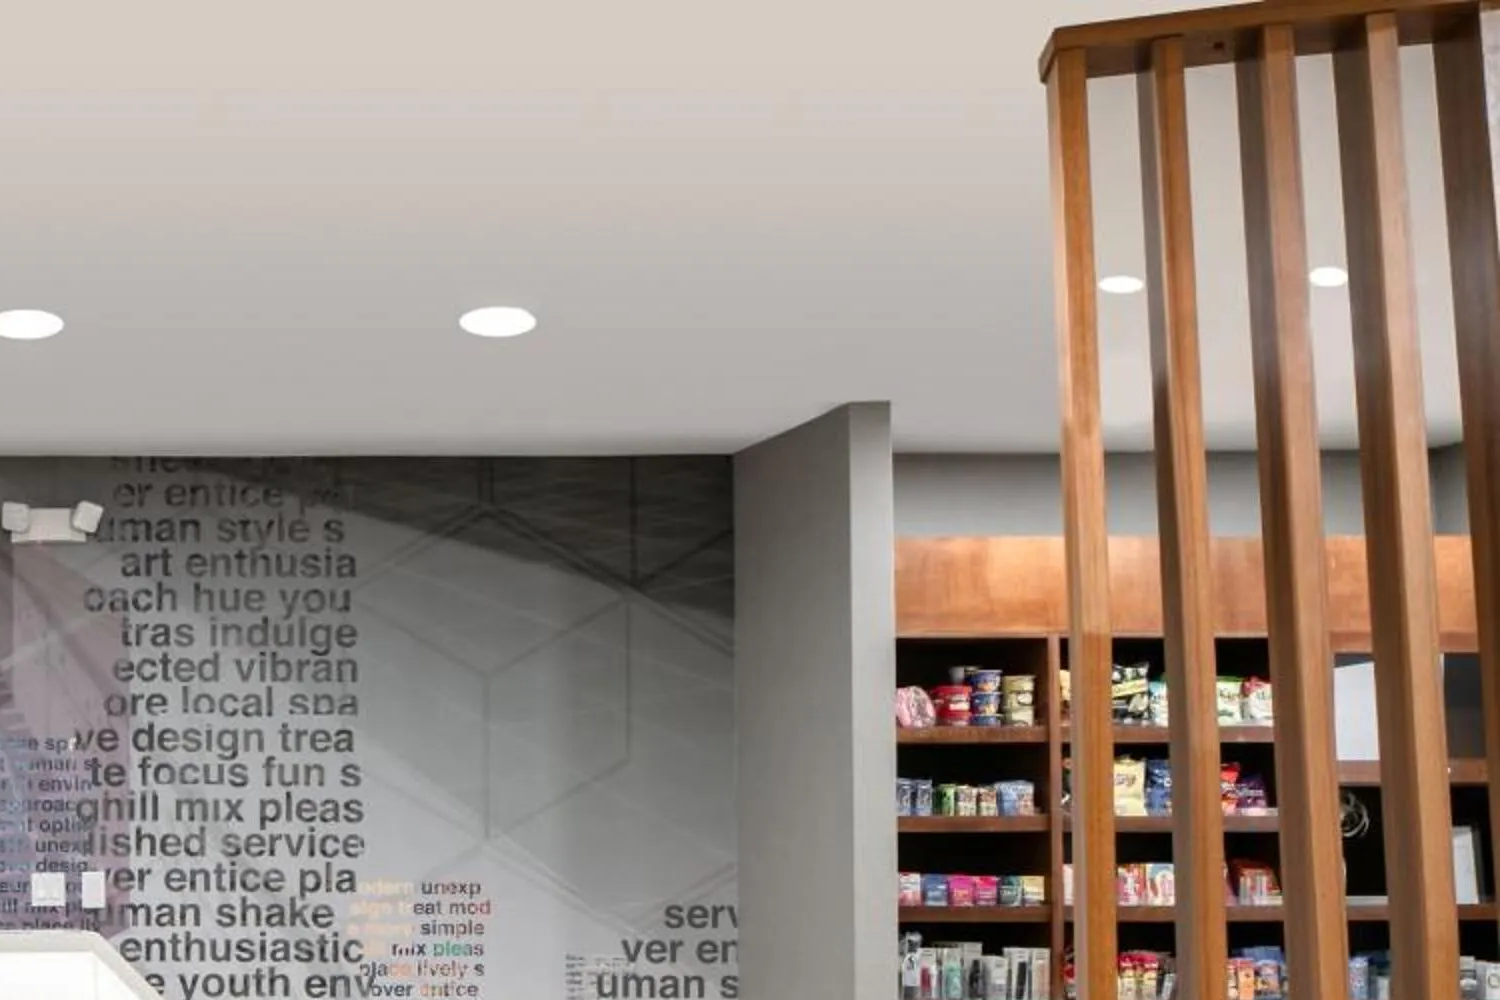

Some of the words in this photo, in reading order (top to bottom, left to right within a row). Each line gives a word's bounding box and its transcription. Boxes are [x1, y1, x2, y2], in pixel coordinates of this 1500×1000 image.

[216, 513, 311, 550] style
[323, 517, 346, 544] s
[120, 548, 174, 578] art
[185, 546, 357, 579] enthusia
[193, 582, 266, 613] hue
[279, 587, 351, 620] you
[121, 617, 195, 648] tras
[209, 616, 358, 656] indulge
[112, 652, 220, 683] ected
[234, 651, 358, 684] vibran
[104, 692, 168, 717] ore
[182, 686, 273, 717] local
[132, 722, 265, 760] design
[279, 722, 354, 752] trea
[138, 756, 249, 787] focus
[263, 756, 325, 787] fun
[339, 763, 362, 787] s
[175, 798, 245, 823] mix
[259, 791, 364, 830] pleas
[221, 827, 364, 858] service
[164, 862, 286, 893] entice
[300, 862, 357, 898] pla
[421, 880, 482, 898] unexp
[215, 897, 335, 928] shake
[420, 919, 485, 937] simple
[119, 931, 364, 964] enthusiastic
[621, 938, 684, 964] ver
